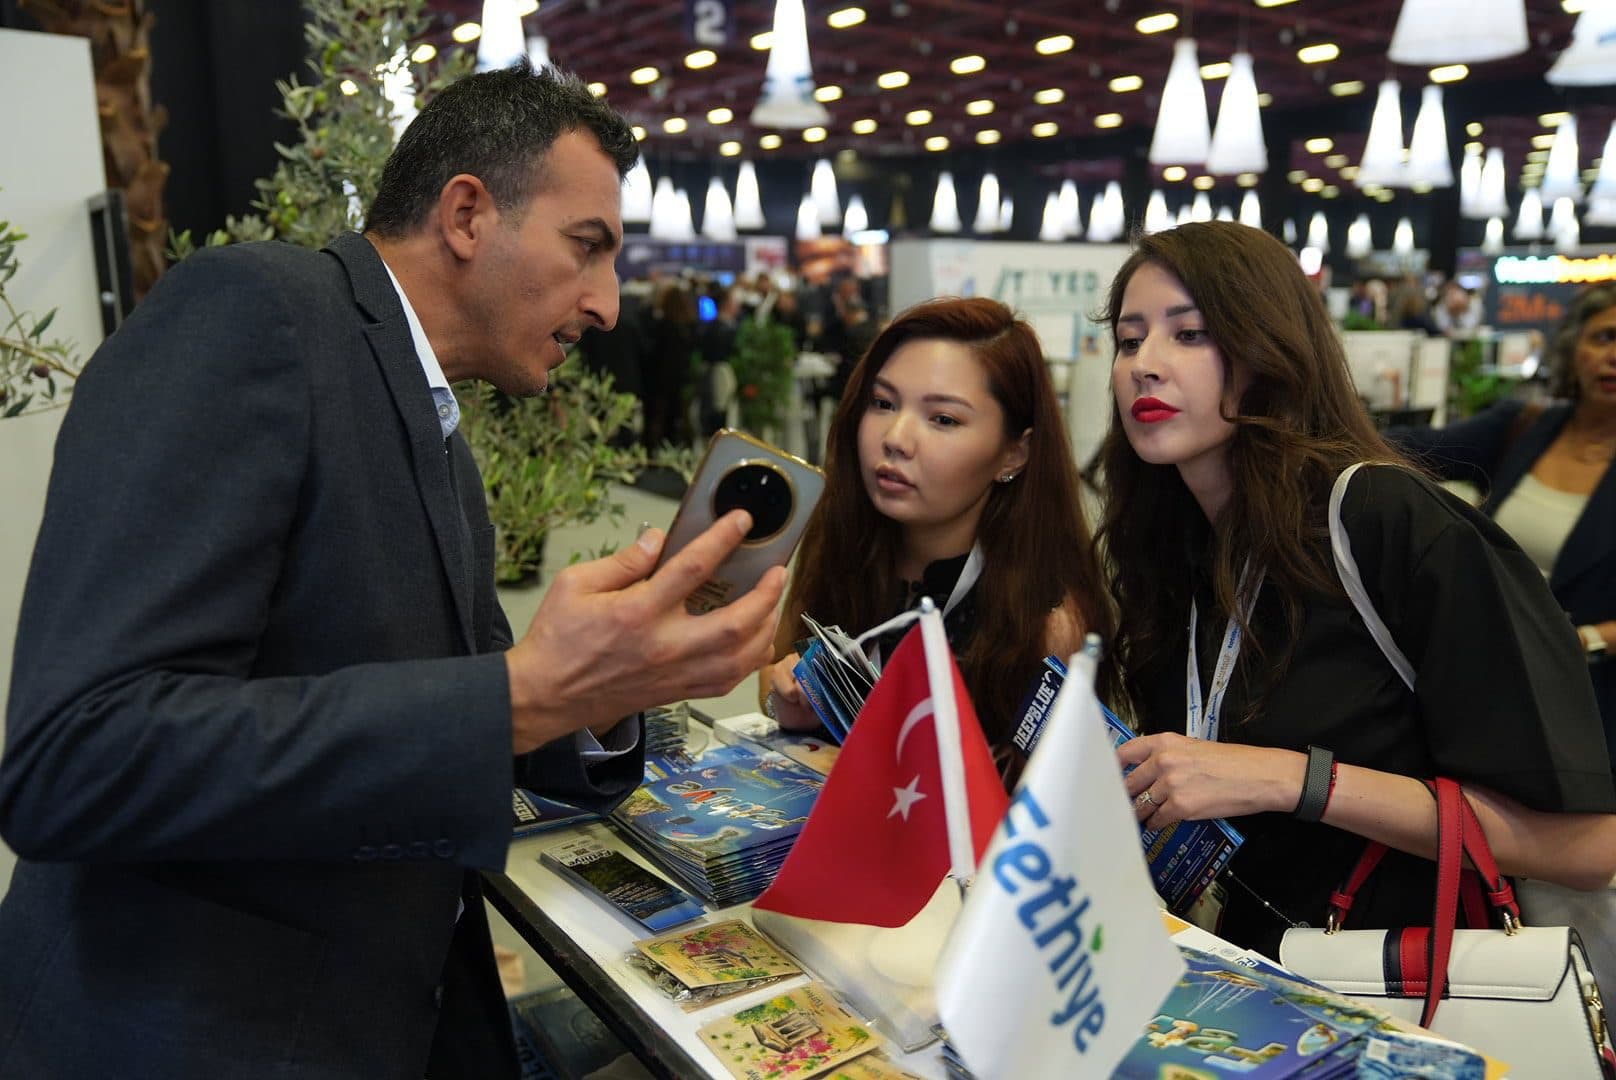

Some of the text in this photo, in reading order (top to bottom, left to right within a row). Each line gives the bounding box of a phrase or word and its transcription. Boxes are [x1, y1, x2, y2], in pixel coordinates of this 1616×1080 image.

[693, 0, 727, 45] 2
[1012, 682, 1056, 751] DEEPBLUE
[993, 784, 1107, 1055] Fethiye
